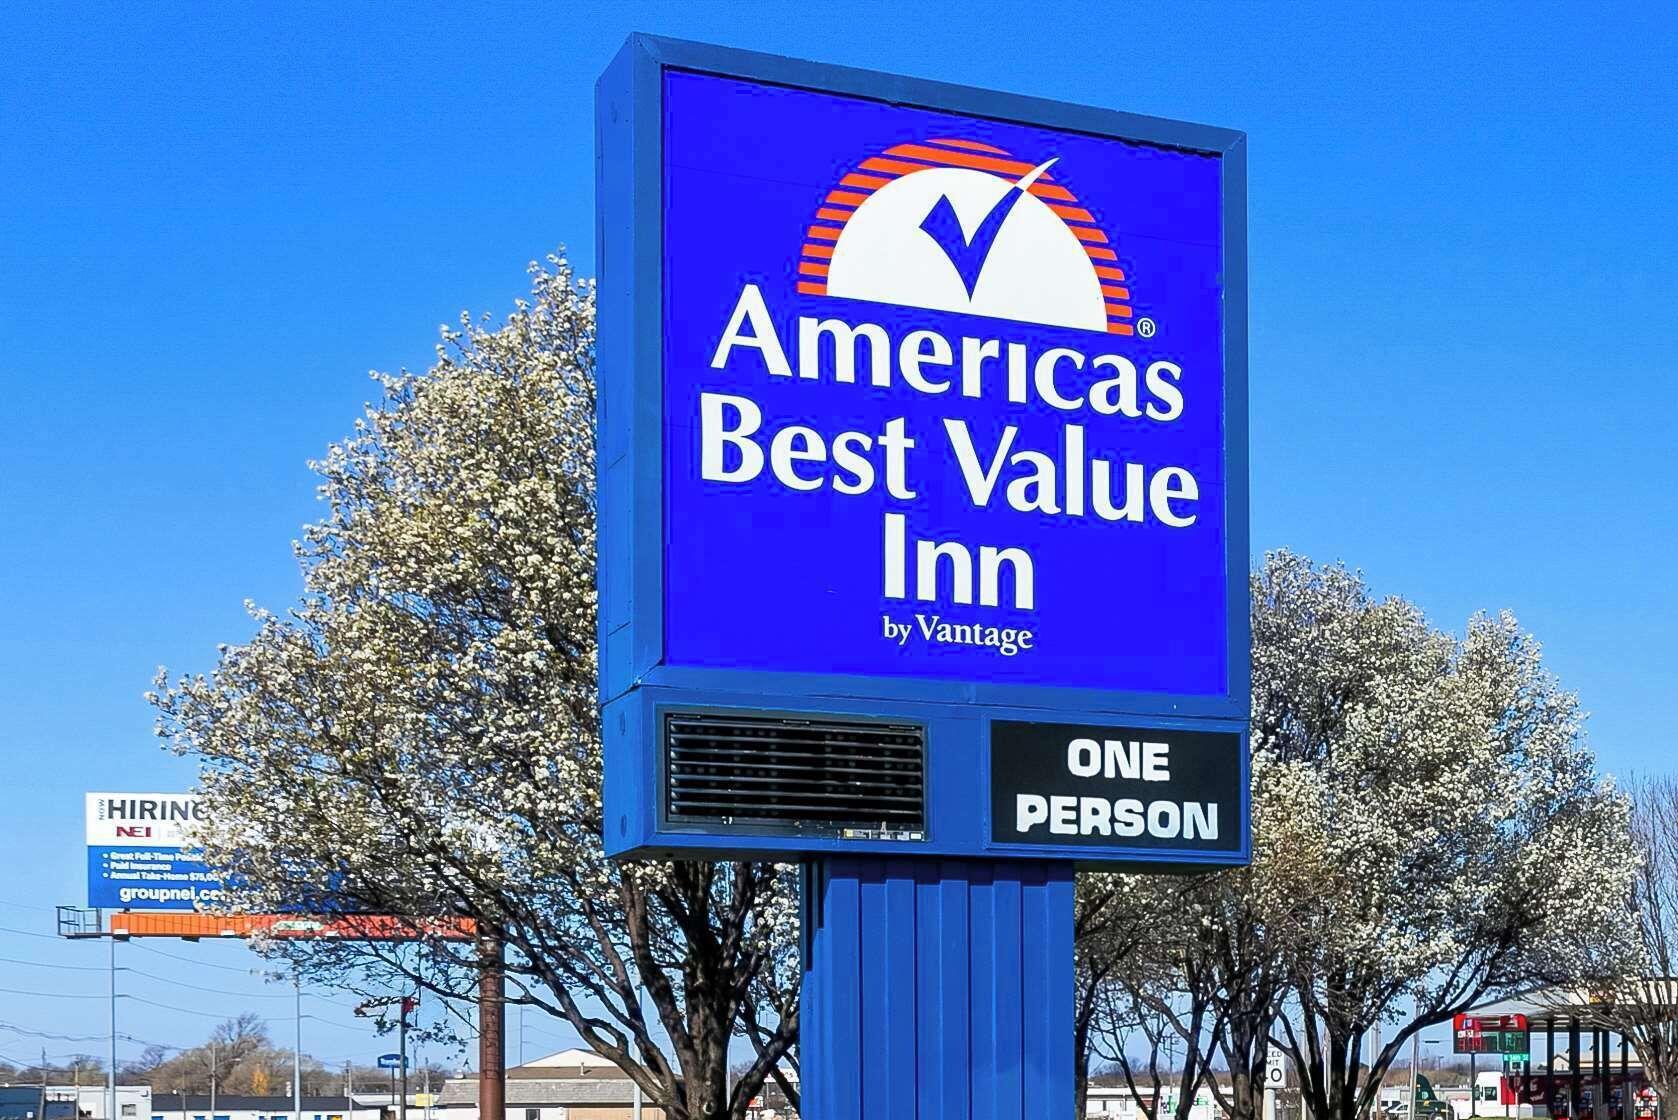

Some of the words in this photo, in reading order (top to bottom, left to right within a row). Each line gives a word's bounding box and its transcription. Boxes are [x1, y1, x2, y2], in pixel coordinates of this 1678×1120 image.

[711, 284, 1184, 421] Americas
[701, 393, 917, 500] Best
[943, 419, 1199, 528] Value
[885, 513, 1034, 610] Inn
[883, 616, 913, 646] by
[915, 615, 1034, 657] Vantage
[1067, 738, 1170, 782] ONE
[116, 826, 152, 838] NEI
[1016, 793, 1219, 840] PERSON
[1265, 1068, 1282, 1083] 0
